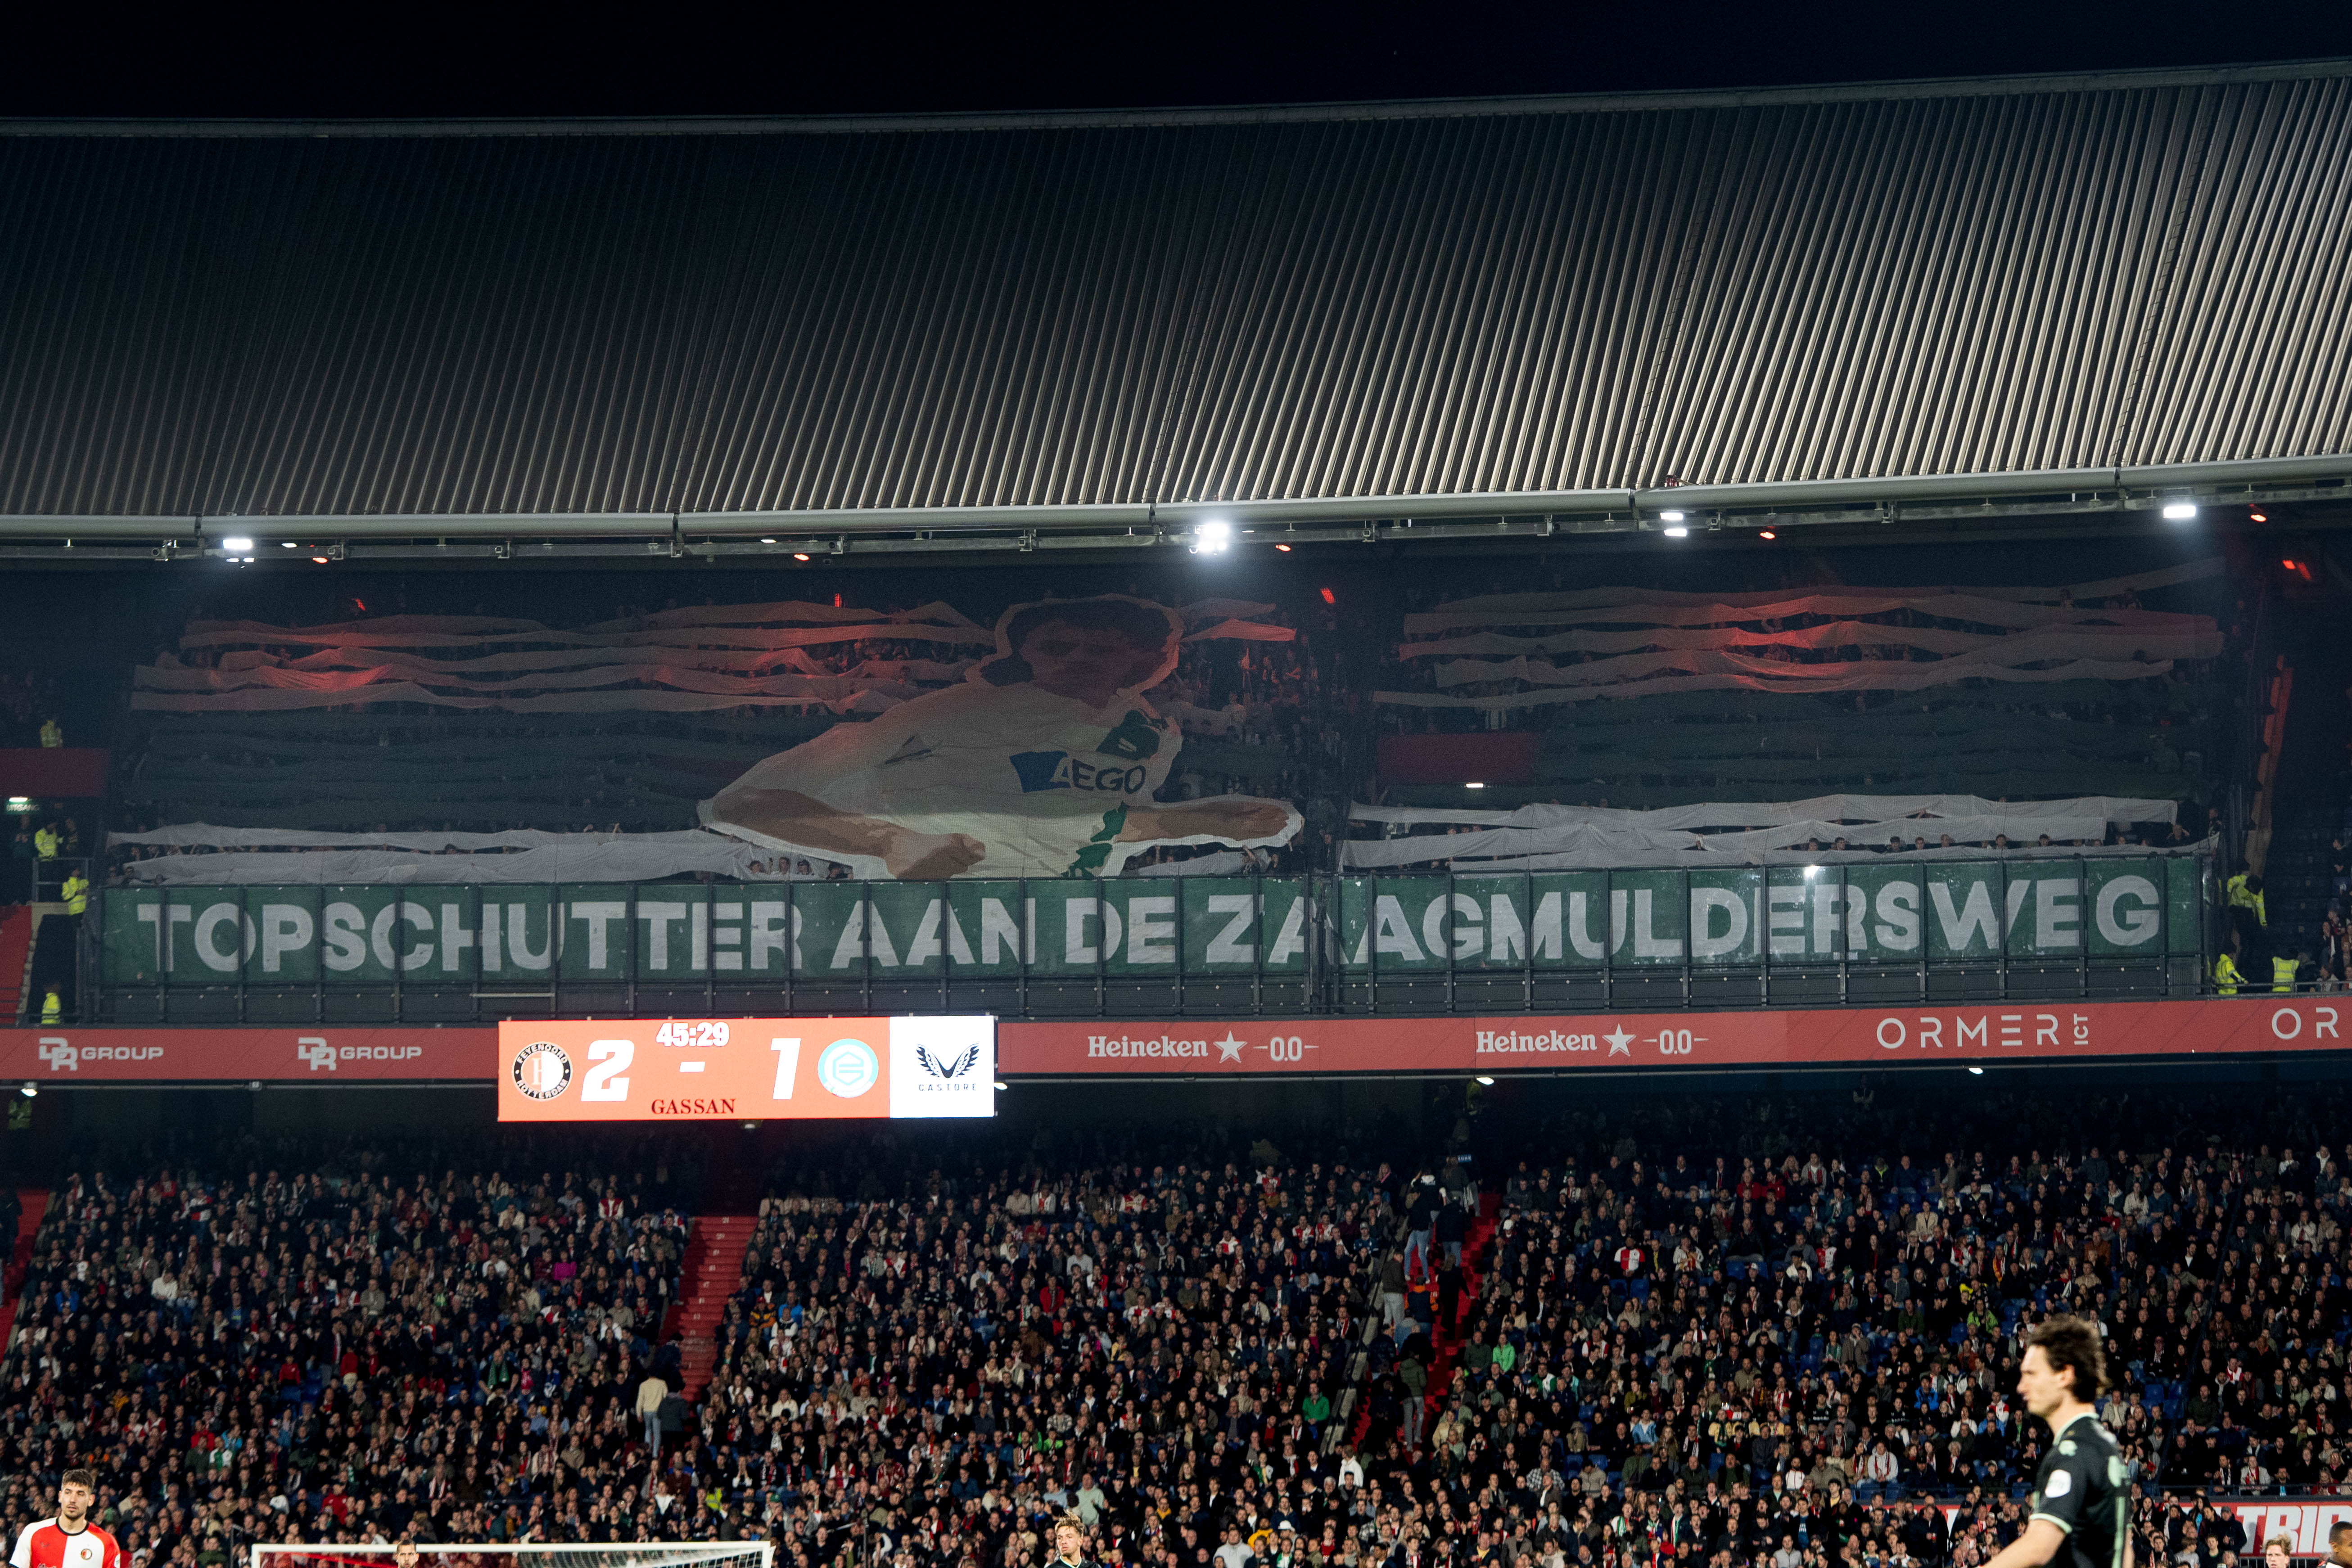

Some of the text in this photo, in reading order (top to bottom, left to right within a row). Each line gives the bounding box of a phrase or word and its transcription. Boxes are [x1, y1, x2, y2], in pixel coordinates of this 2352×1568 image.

[138, 875, 2160, 972] TOPSCHUTTER AAN DE ZAAGMULDERSWEG
[1877, 1014, 2060, 1049] ORMER
[2074, 1013, 2089, 1045] ICT
[2271, 1007, 2339, 1039] OR
[656, 1022, 729, 1047] 45:29
[1476, 1030, 1597, 1053] Heineken
[81, 1047, 164, 1060] GROUP
[340, 1046, 422, 1059] GROUP
[517, 1044, 568, 1064] FEYENOORD
[1088, 1035, 1209, 1057] Heineken
[581, 1039, 635, 1102] 2
[771, 1038, 801, 1099] 1
[517, 1079, 568, 1099] ROTTERDAM
[919, 1083, 977, 1091] CASTORE
[651, 1098, 736, 1114] GASSAN
